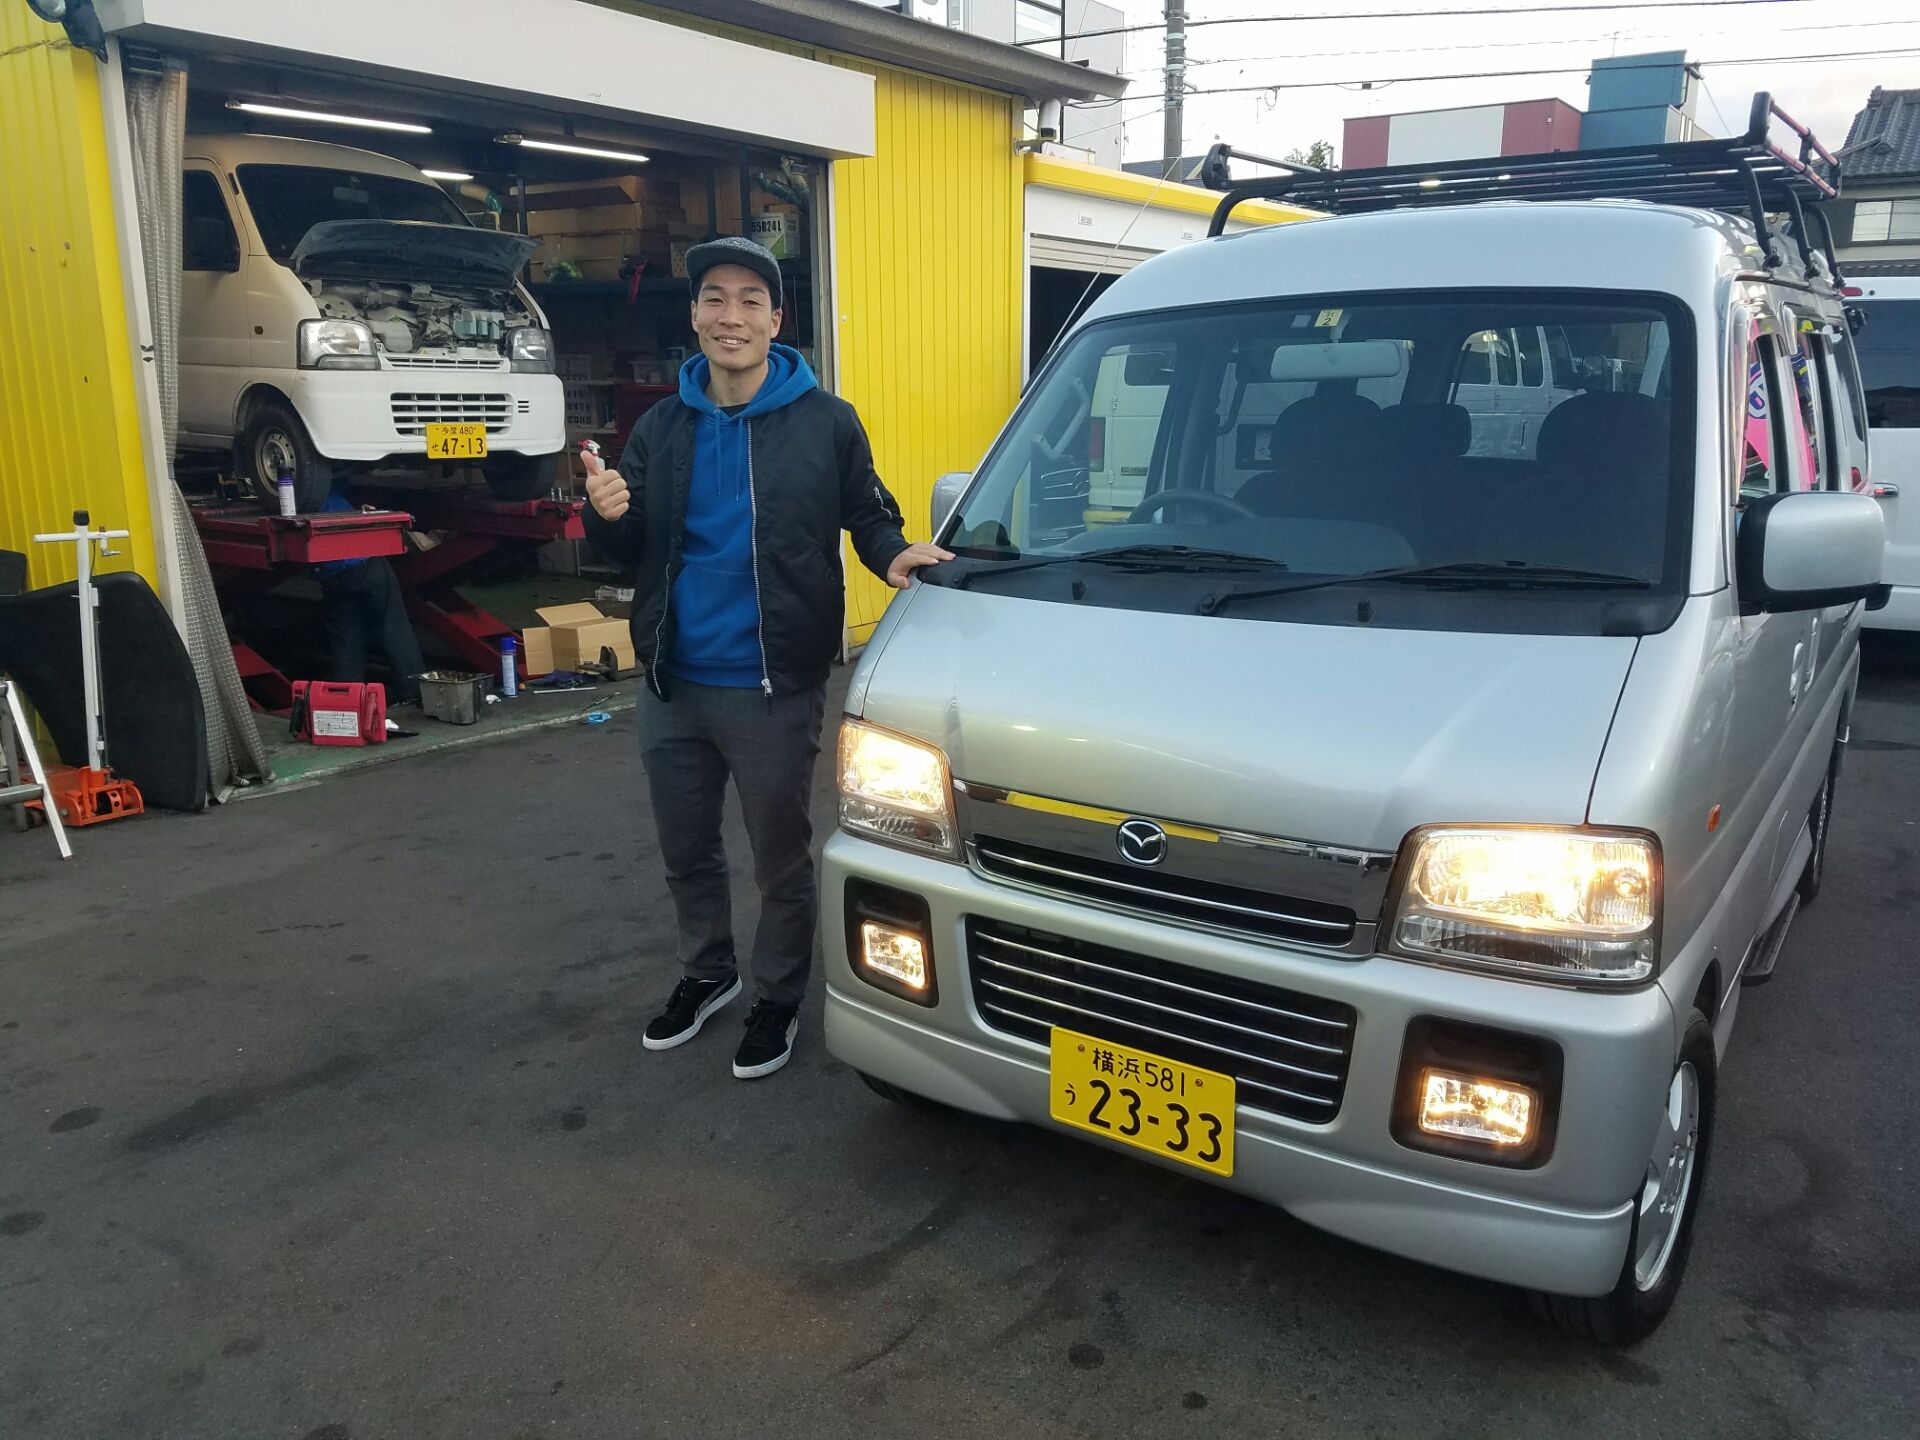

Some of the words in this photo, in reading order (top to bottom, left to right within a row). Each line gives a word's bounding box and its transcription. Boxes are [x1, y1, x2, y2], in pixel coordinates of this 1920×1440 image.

[1322, 317, 1332, 326] 2
[431, 442, 439, 452] せ
[442, 437, 484, 455] 47-13
[1064, 1082, 1076, 1106] う
[1088, 1079, 1222, 1163] 23-33
